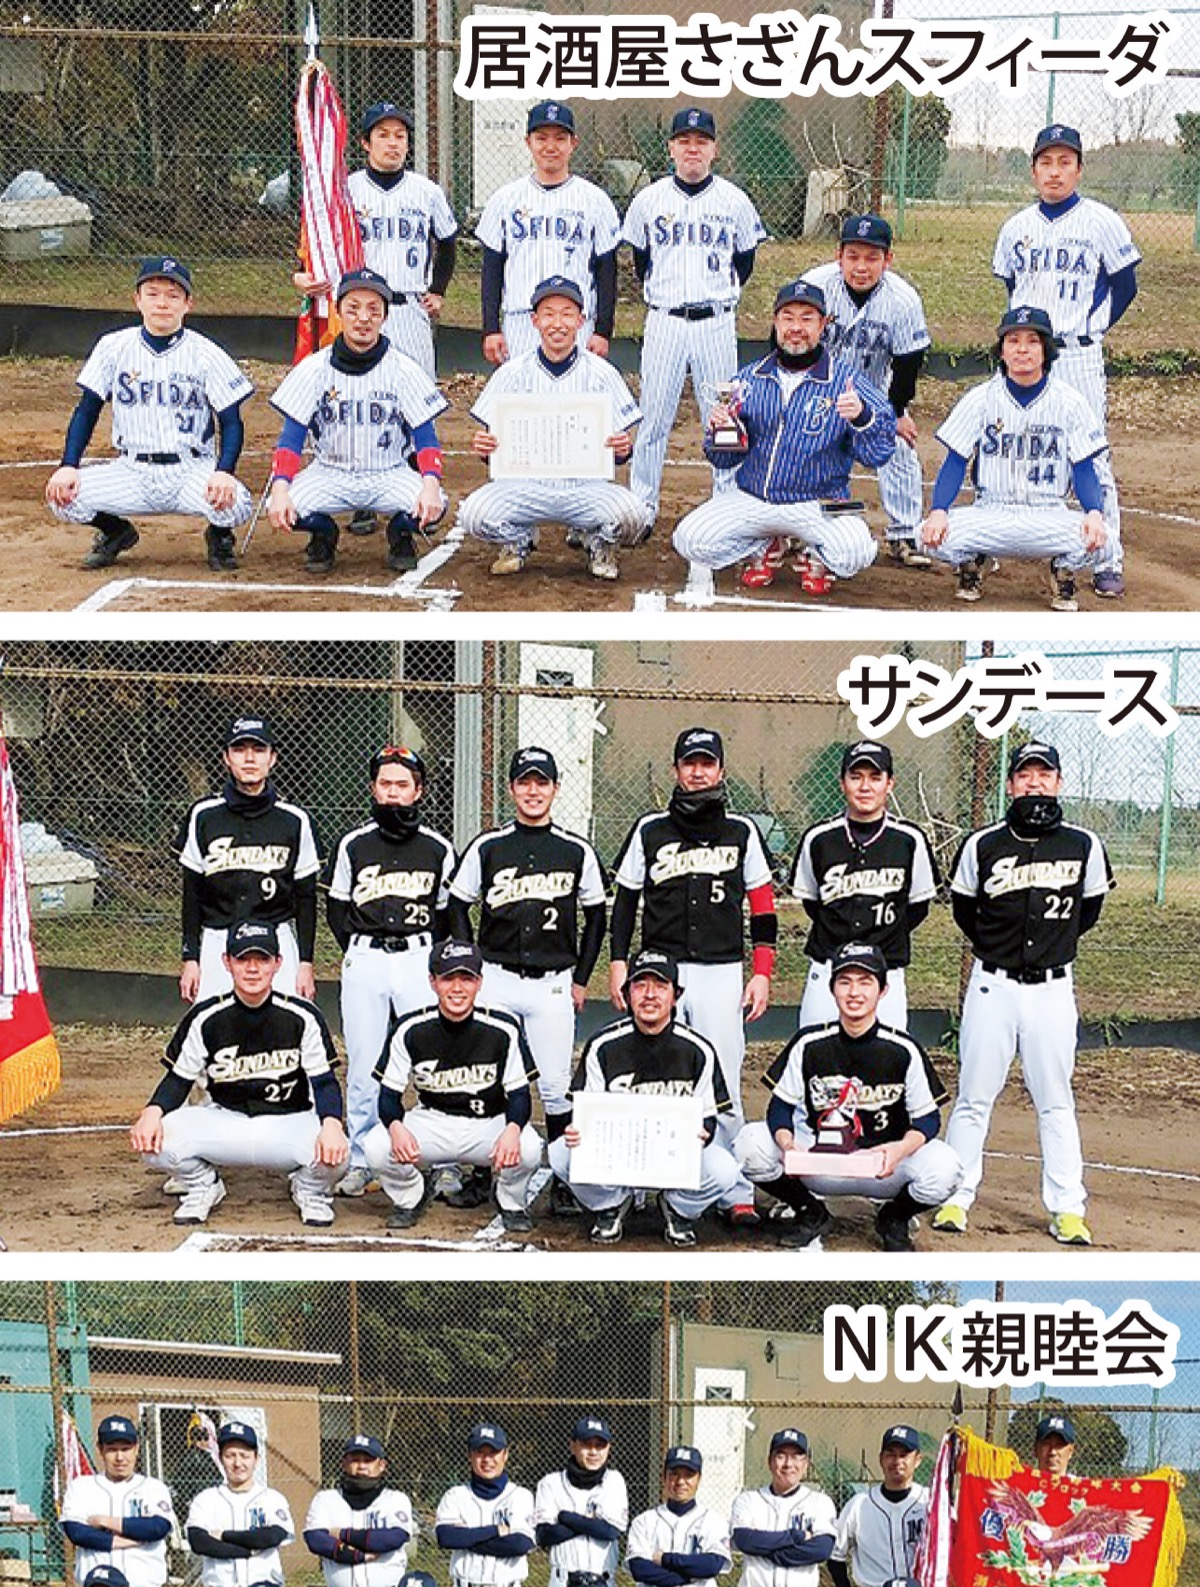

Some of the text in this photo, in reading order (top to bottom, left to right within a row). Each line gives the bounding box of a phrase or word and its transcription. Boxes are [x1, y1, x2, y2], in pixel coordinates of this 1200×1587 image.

[1057, 279, 1079, 301] 11
[1028, 464, 1057, 485] 44
[261, 877, 277, 900] 9
[710, 880, 726, 903] 5
[405, 903, 430, 926] 25
[542, 906, 559, 930] 2
[871, 902, 896, 926] 16
[1043, 895, 1074, 920] 22
[264, 1080, 298, 1102] 27
[873, 1110, 889, 1132] 3
[1102, 1533, 1134, 1564] 勝
